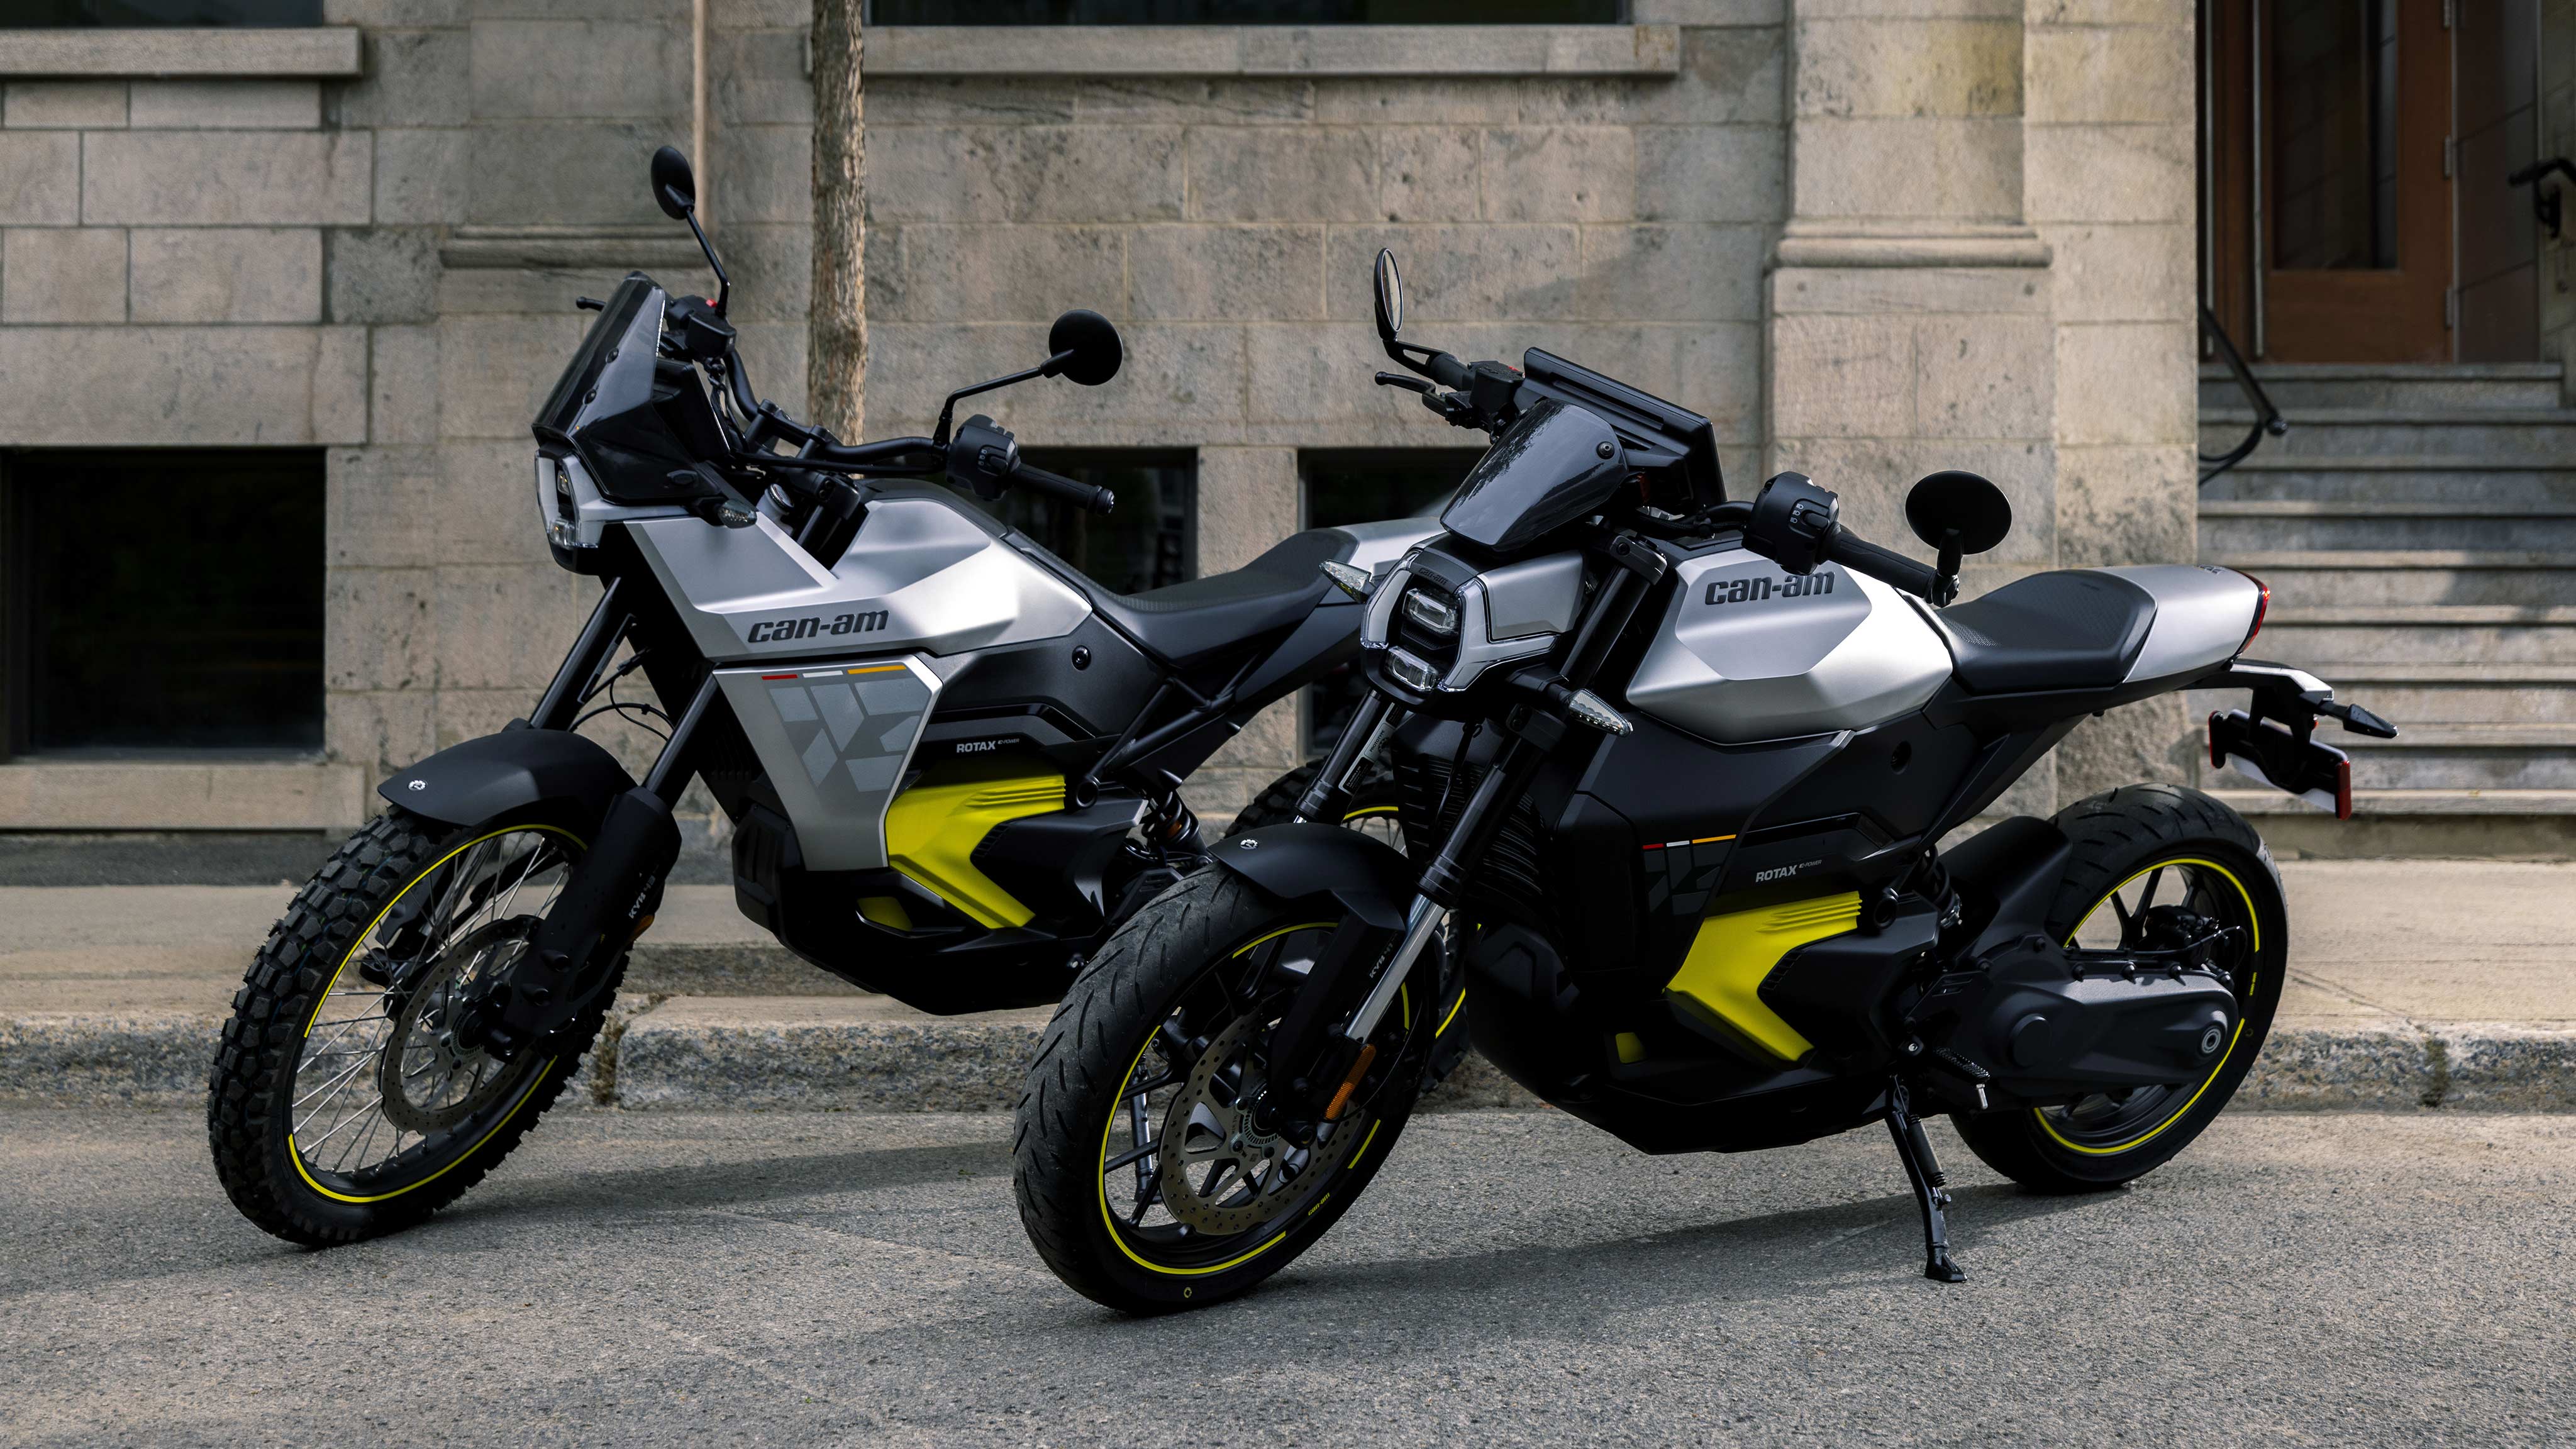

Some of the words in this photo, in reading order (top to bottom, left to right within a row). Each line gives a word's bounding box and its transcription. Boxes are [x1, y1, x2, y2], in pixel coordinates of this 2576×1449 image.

[1704, 570, 1836, 605] can-am
[747, 609, 890, 643] can-am
[956, 740, 996, 753] ROTAX
[1755, 865, 1797, 883] ROTAX
[1308, 1192, 1331, 1216] can-am
